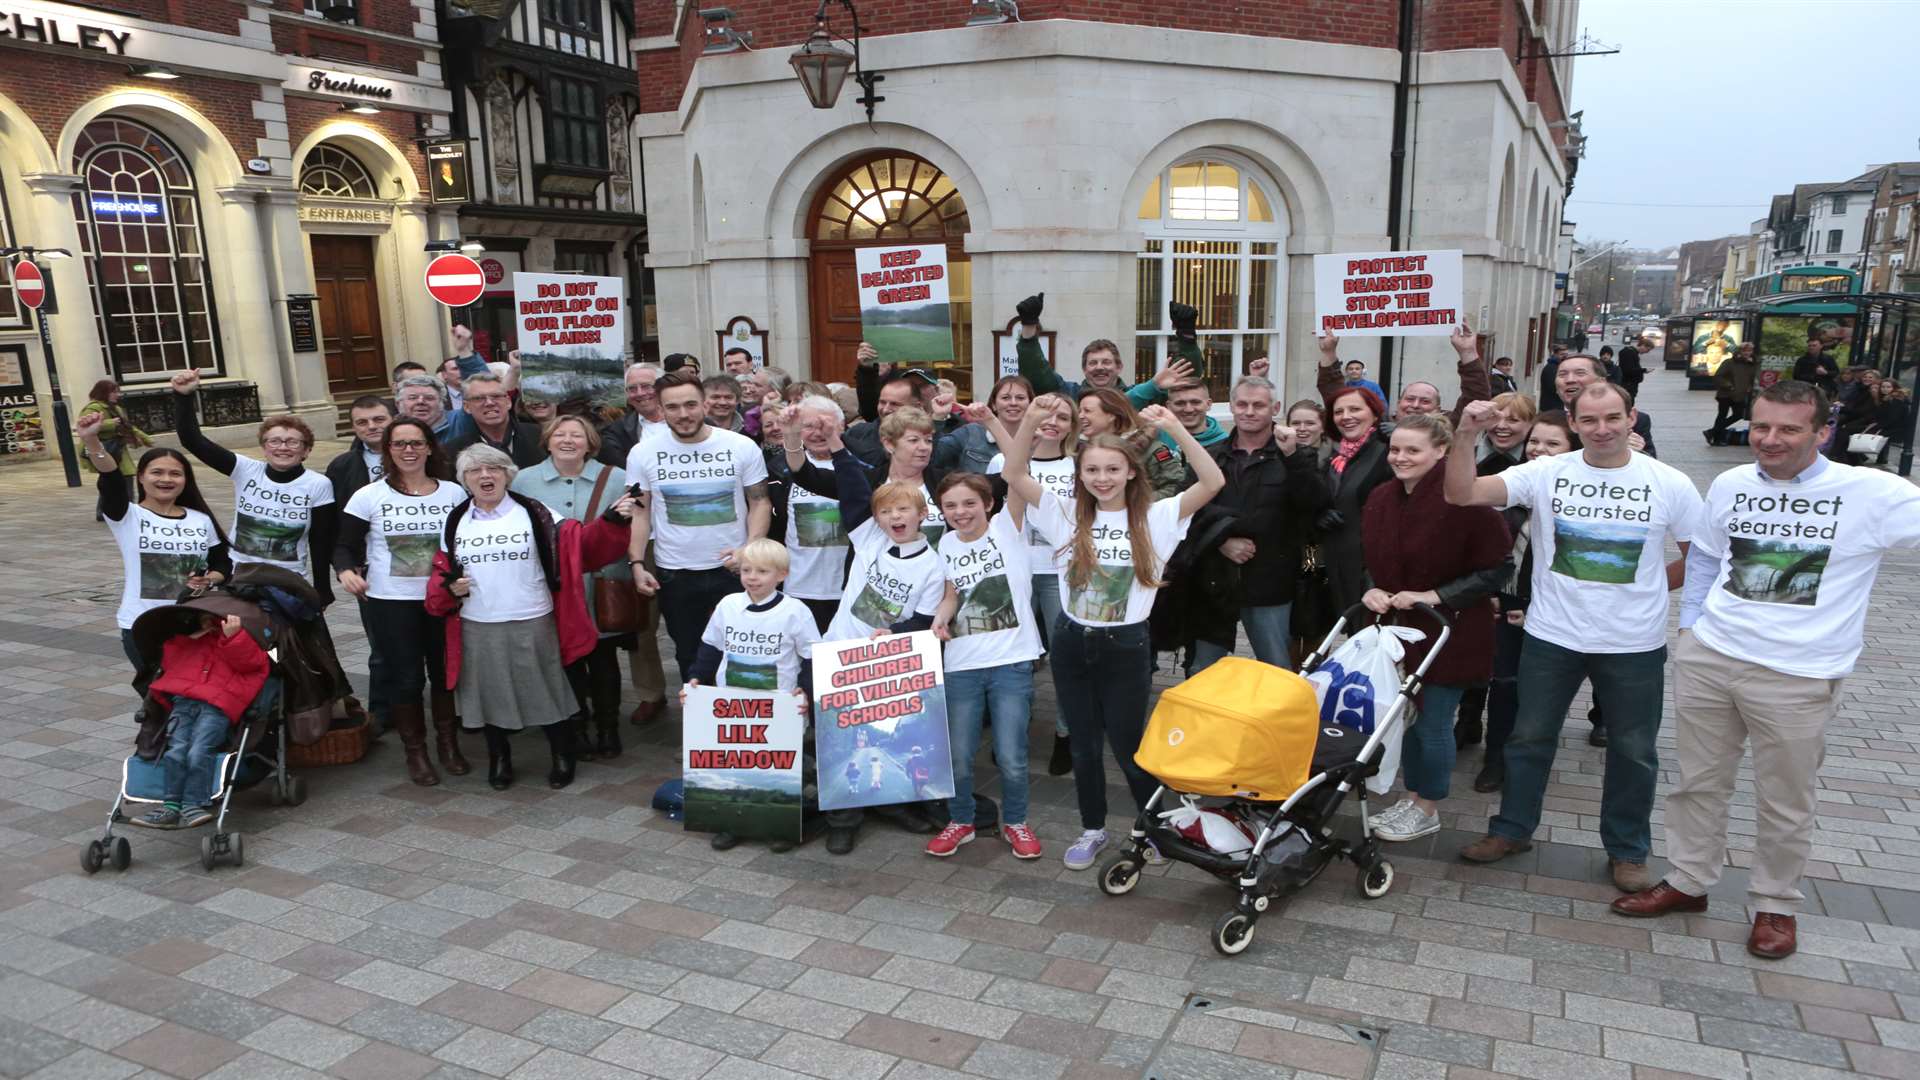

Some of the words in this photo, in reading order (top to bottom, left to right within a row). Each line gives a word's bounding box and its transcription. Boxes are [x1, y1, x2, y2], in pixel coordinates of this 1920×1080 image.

[308, 70, 393, 100] Freehouse
[309, 207, 381, 221] ENTRANCE
[880, 249, 921, 268] KEEP
[1347, 255, 1427, 275] PROTECT
[484, 271, 502, 279] FFICE
[861, 264, 943, 288] BEARSTED
[1343, 274, 1433, 294] BEARSTED
[537, 283, 561, 298] DO
[565, 281, 598, 296] NOT
[877, 284, 931, 304] GREEN
[519, 298, 592, 315] DEVELOP
[595, 297, 618, 311] ON
[1346, 294, 1391, 312] STOP
[1394, 292, 1430, 309] THE
[524, 316, 559, 331] OUR
[562, 314, 615, 329] FLOOD
[1322, 308, 1456, 330] DEVELOPMENT!
[539, 330, 601, 345] PLAINS!
[0, 394, 34, 406] ALS
[656, 449, 733, 466] Protect
[657, 464, 735, 480] Bearsted
[243, 479, 311, 507] Protect
[1554, 478, 1652, 502] Protect
[239, 496, 308, 520] Bearsted
[1551, 497, 1652, 522] Bearsted
[1733, 493, 1843, 516] Protect
[140, 519, 207, 537] Protec
[384, 520, 443, 532] Bearst
[1728, 518, 1838, 540] Bearsted
[139, 536, 208, 551] Bearste
[456, 547, 530, 565] earsted
[725, 626, 784, 644] Protect
[837, 636, 913, 667] VILLAGE
[832, 653, 923, 688] CHILDREN
[821, 689, 859, 711] FOR
[860, 671, 936, 702] VILLAGE
[713, 698, 774, 718] SAVE
[837, 696, 922, 728] SCHOOLS
[718, 724, 769, 744] LILK
[690, 750, 797, 769] MEADOW
